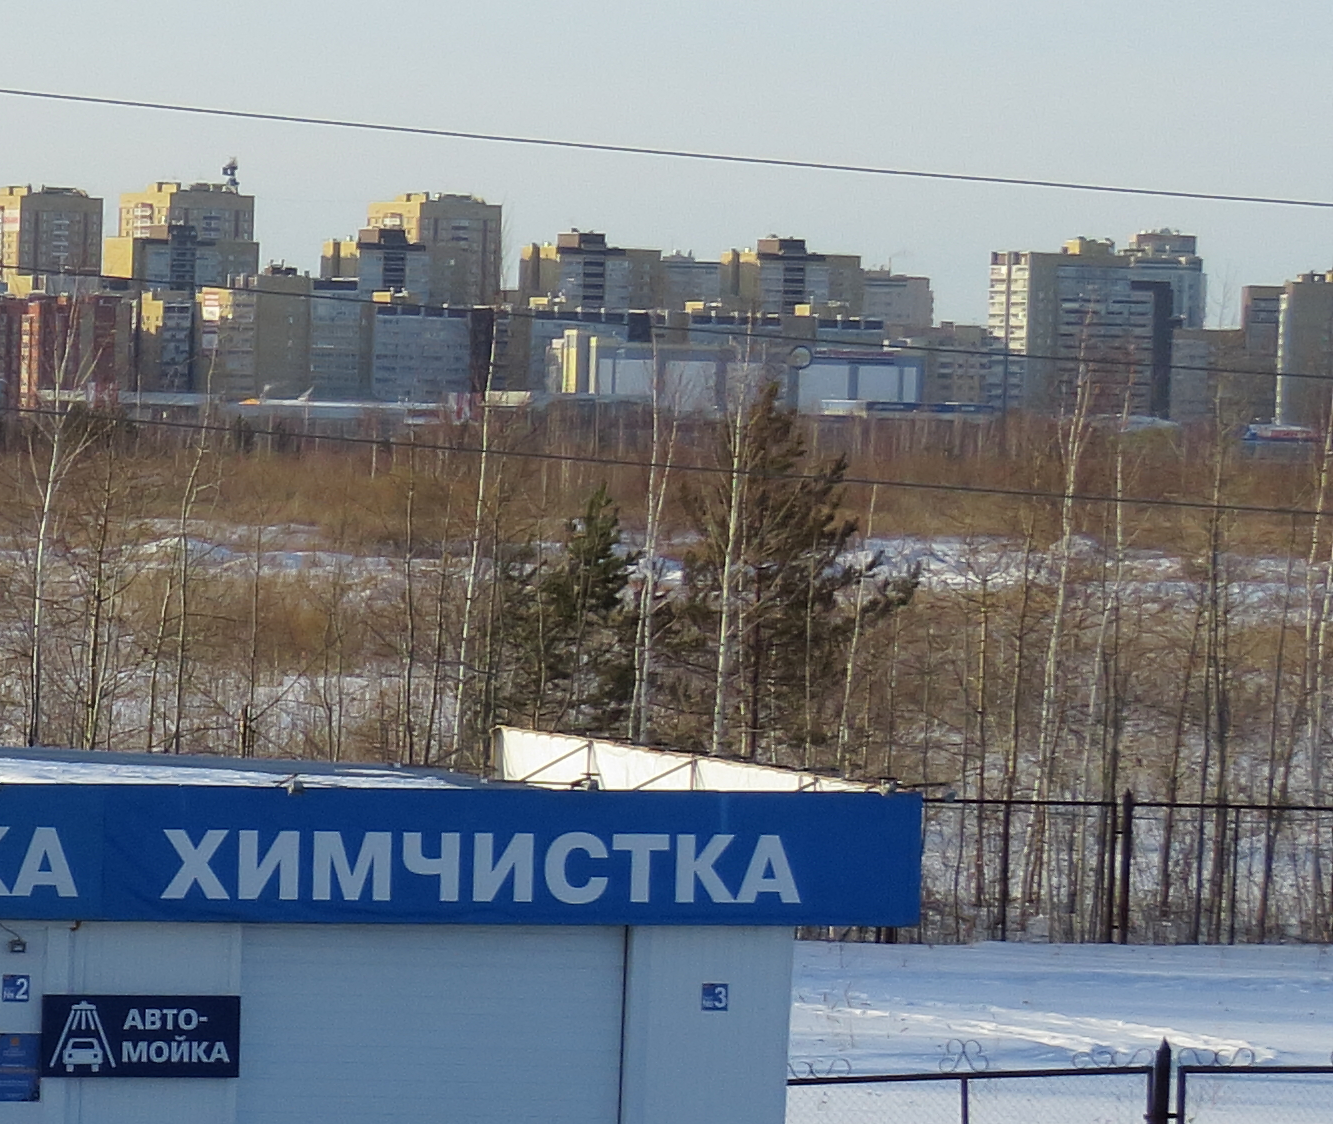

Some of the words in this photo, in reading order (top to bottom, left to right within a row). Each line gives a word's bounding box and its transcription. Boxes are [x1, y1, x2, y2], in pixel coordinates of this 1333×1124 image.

[161, 829, 801, 904] ХИМЧИСТКА
[123, 1009, 208, 1030] АВТО-
[121, 1035, 230, 1063] МОЙКА
